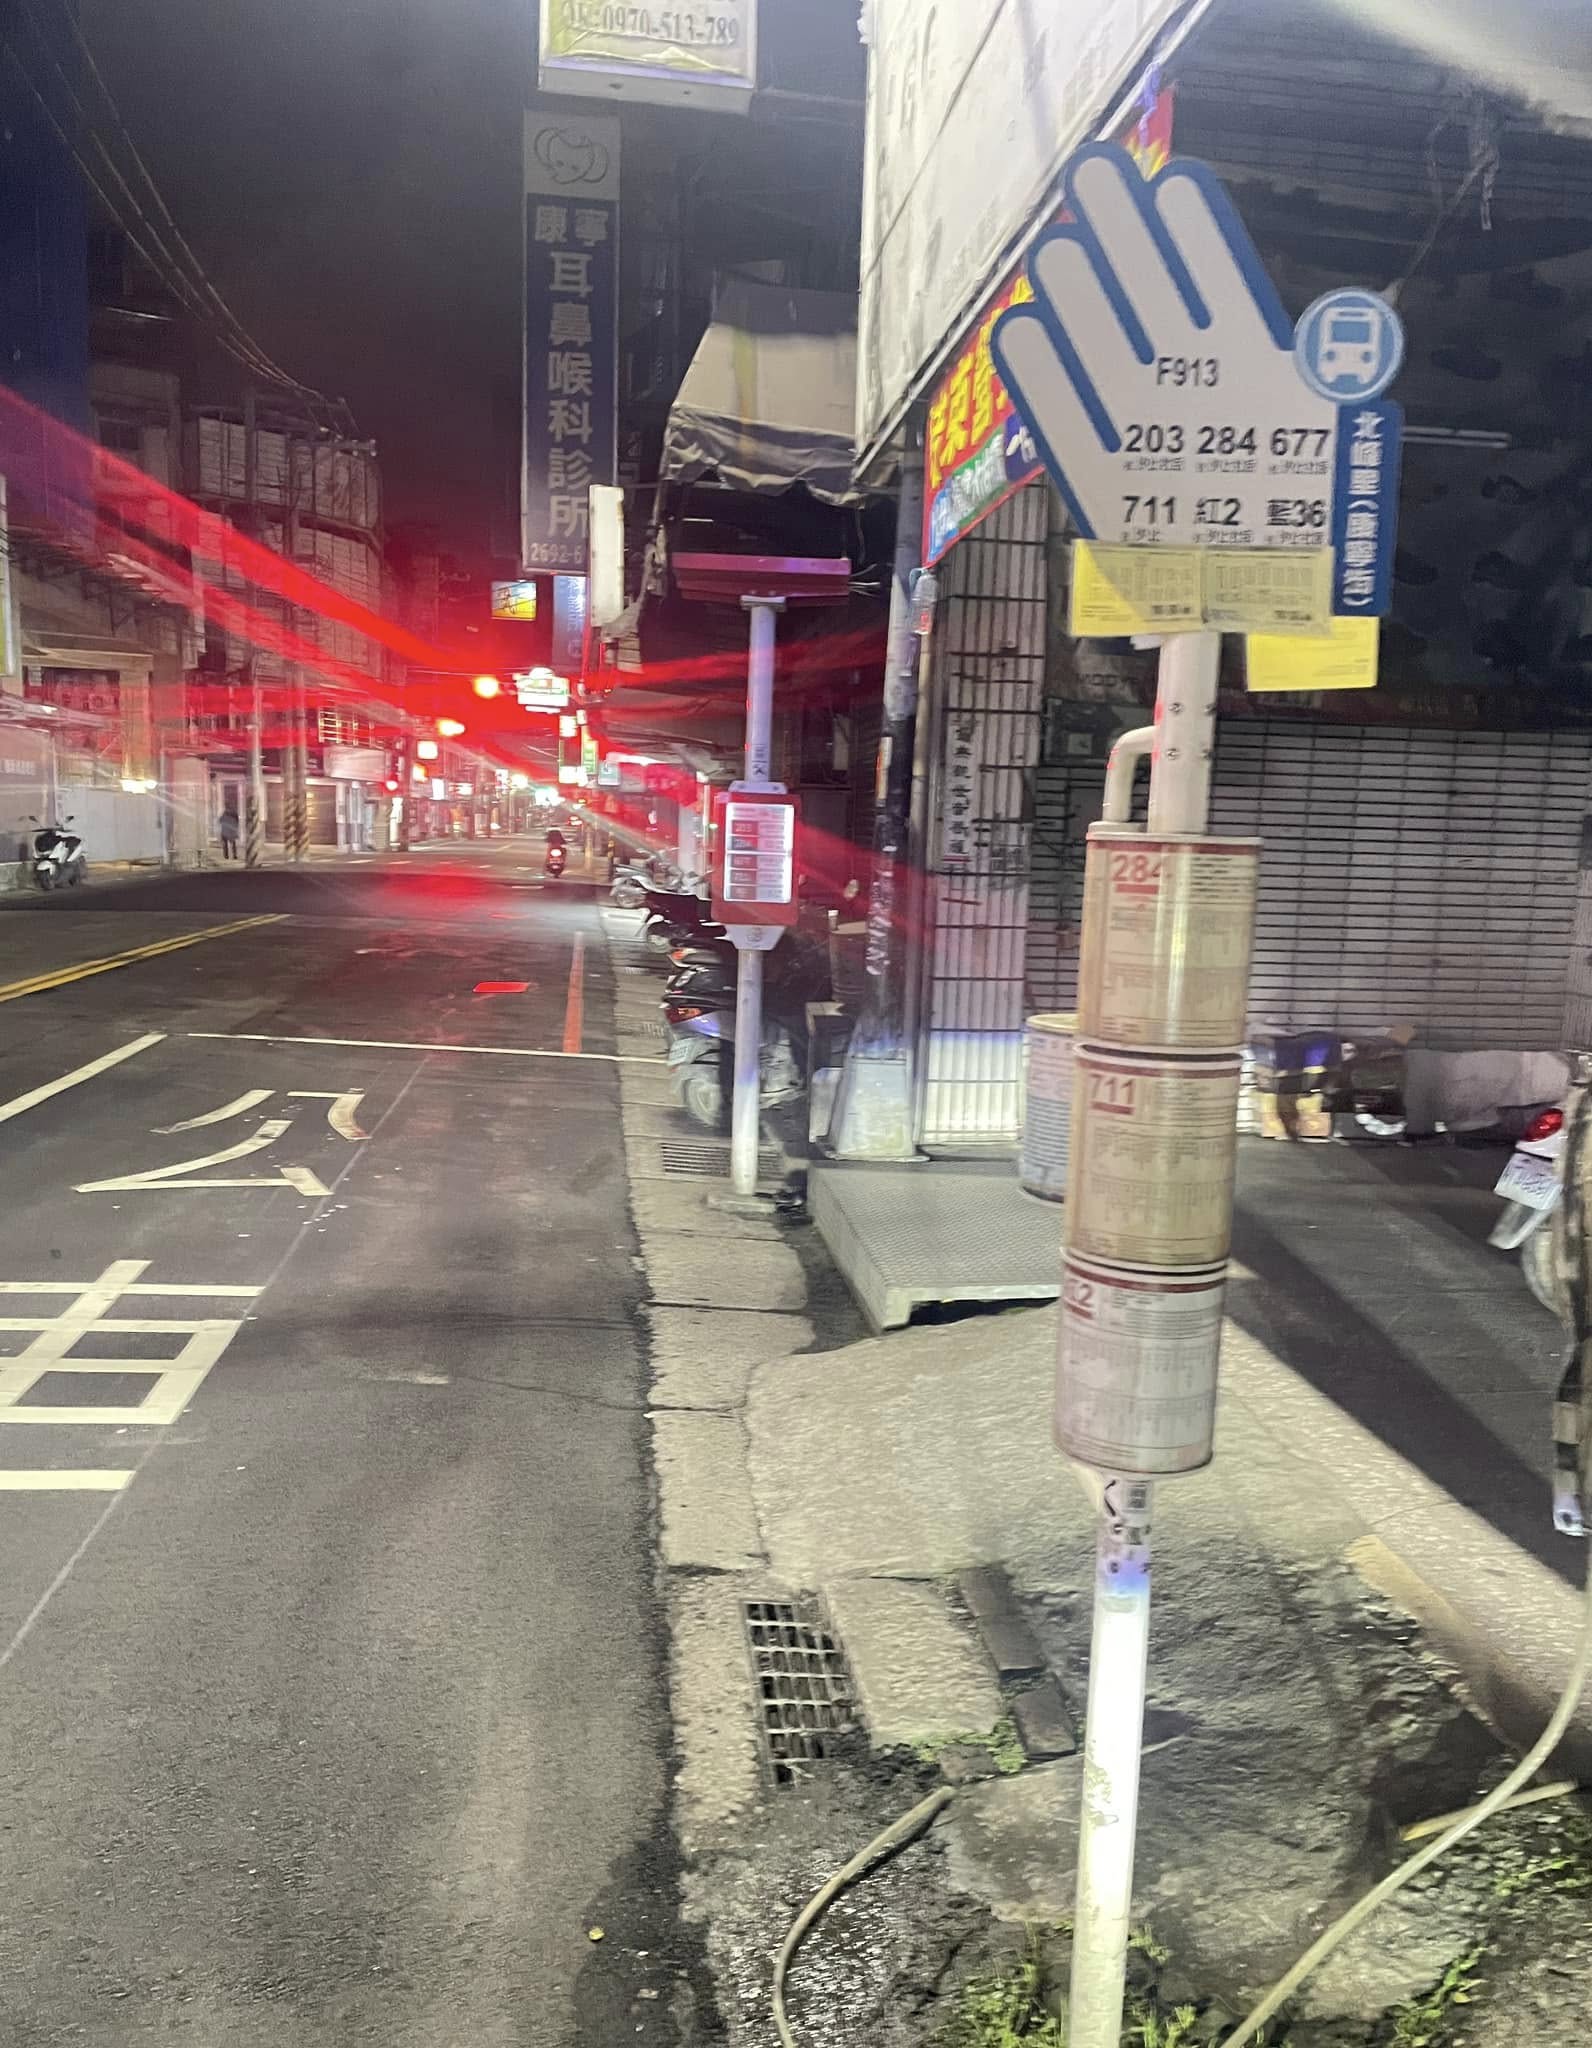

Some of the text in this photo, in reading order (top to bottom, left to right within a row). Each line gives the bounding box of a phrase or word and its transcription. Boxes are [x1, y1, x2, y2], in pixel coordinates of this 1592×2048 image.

[1157, 357, 1218, 387] F913
[548, 250, 593, 539] 耳鼻喉科診所
[1123, 424, 1331, 457] 203 284 677
[1122, 495, 1177, 525] 711
[1194, 497, 1241, 526] 紅2
[1112, 854, 1173, 883] 284
[1089, 1073, 1137, 1105] 711
